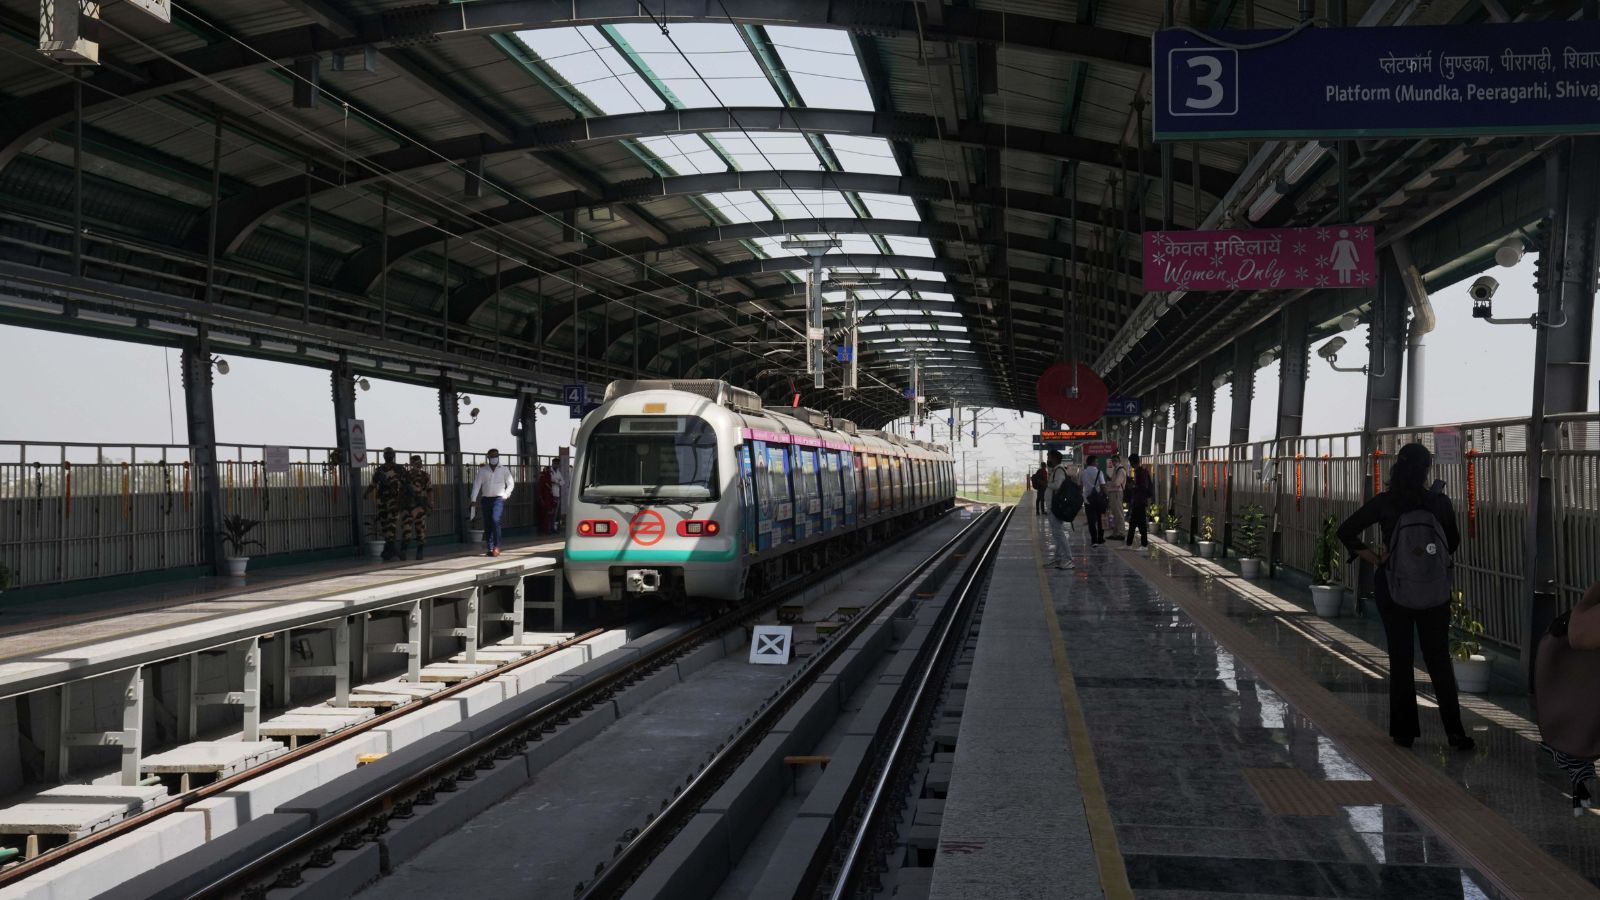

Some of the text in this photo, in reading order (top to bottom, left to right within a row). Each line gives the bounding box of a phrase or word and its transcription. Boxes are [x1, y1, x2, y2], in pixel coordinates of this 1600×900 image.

[1378, 50, 1433, 75] प्लेटफॉर्म
[1440, 50, 1494, 80] (मुण्डका,
[1185, 55, 1224, 109] 3
[1325, 85, 1391, 102] Platform
[1395, 84, 1463, 103] (Mundka,
[1467, 82, 1552, 103] Peeragarhi,
[1164, 233, 1283, 257] केवल महिलायें
[1163, 258, 1287, 288] Women Only
[569, 388, 579, 402] 4
[573, 404, 581, 414] 4
